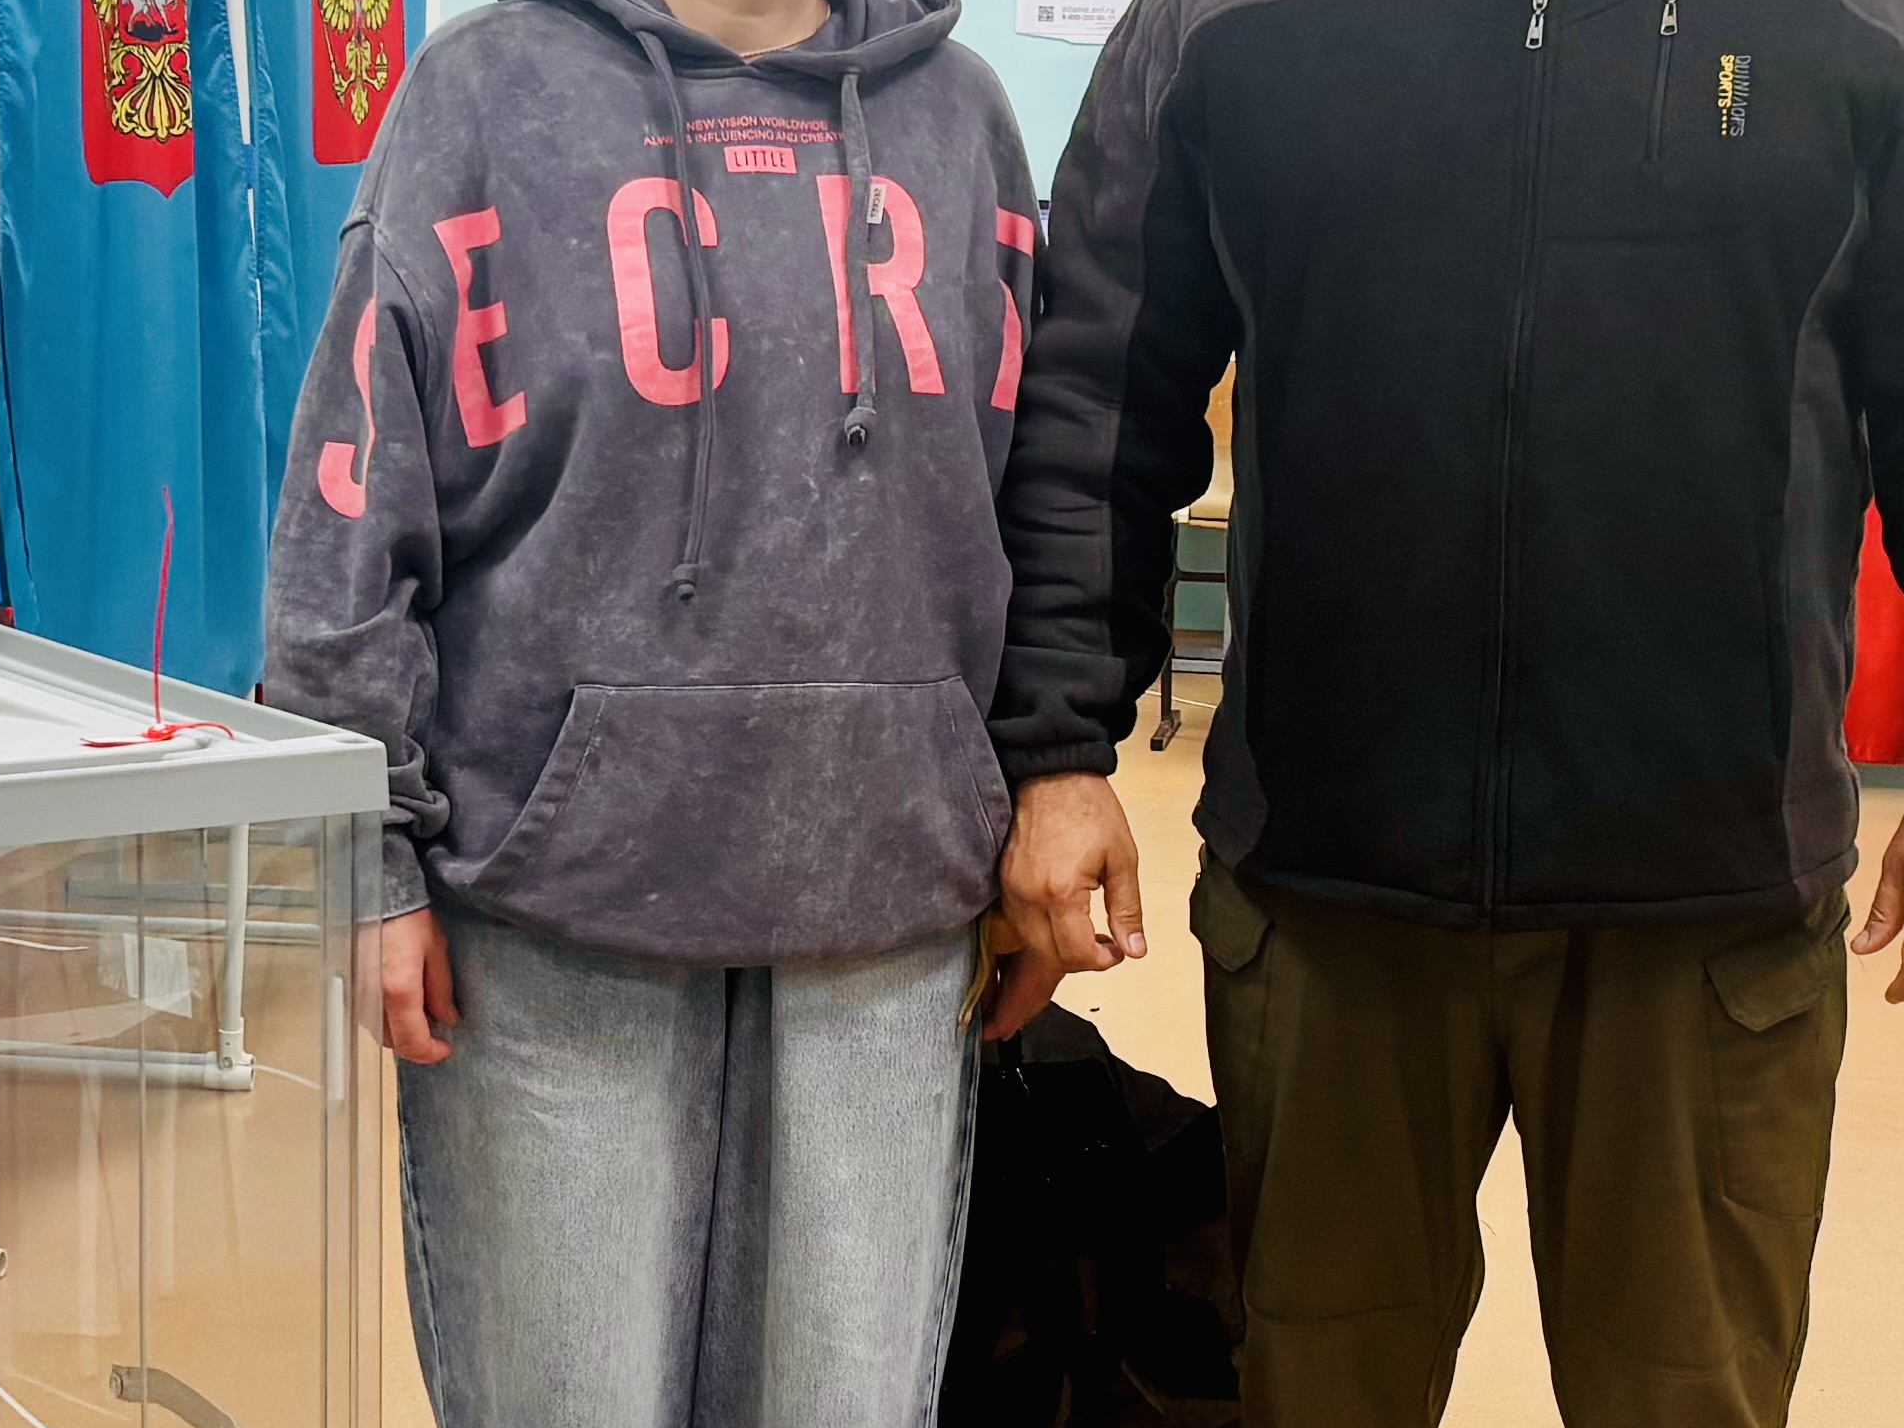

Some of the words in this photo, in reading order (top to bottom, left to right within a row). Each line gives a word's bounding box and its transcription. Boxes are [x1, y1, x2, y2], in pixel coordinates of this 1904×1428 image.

[686, 118, 715, 132] NEW
[717, 115, 758, 129] VISION
[759, 116, 830, 132] WORLDWIDE
[695, 129, 774, 143] INFLUENCING
[733, 150, 786, 169] LITTLE
